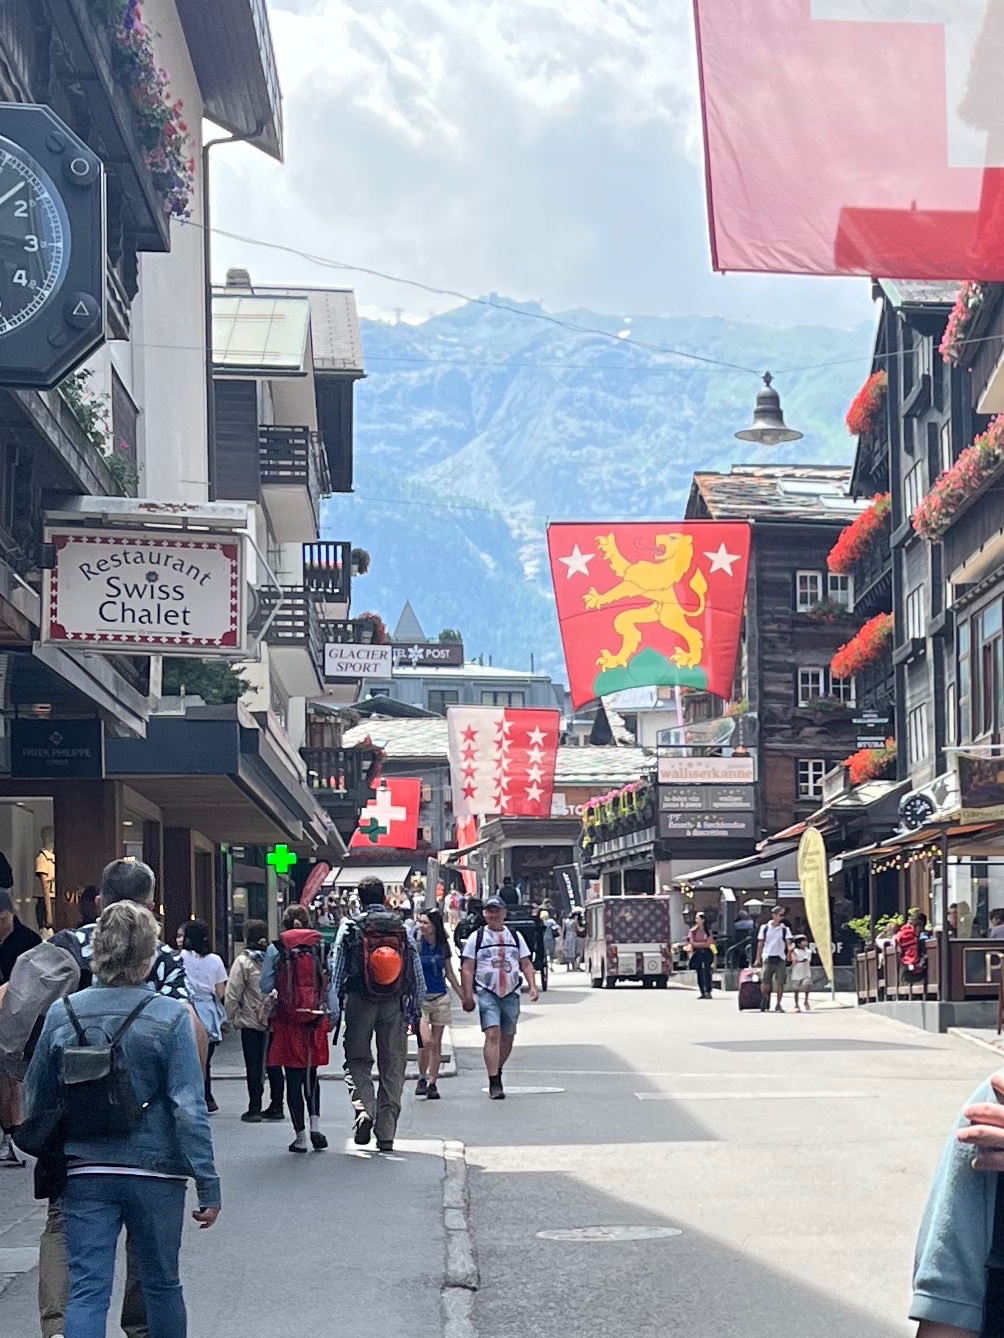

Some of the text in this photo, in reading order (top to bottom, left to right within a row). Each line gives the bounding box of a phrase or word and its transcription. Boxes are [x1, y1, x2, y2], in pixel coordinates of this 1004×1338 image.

[14, 200, 29, 217] 2
[24, 235, 39, 252] 3
[13, 270, 28, 287] 4
[78, 550, 211, 586] Restaurant
[105, 576, 185, 601] Swiss
[98, 601, 191, 626] Chalet
[328, 649, 388, 661] GLACIER
[425, 648, 450, 659] POST
[336, 662, 381, 673] SPORT
